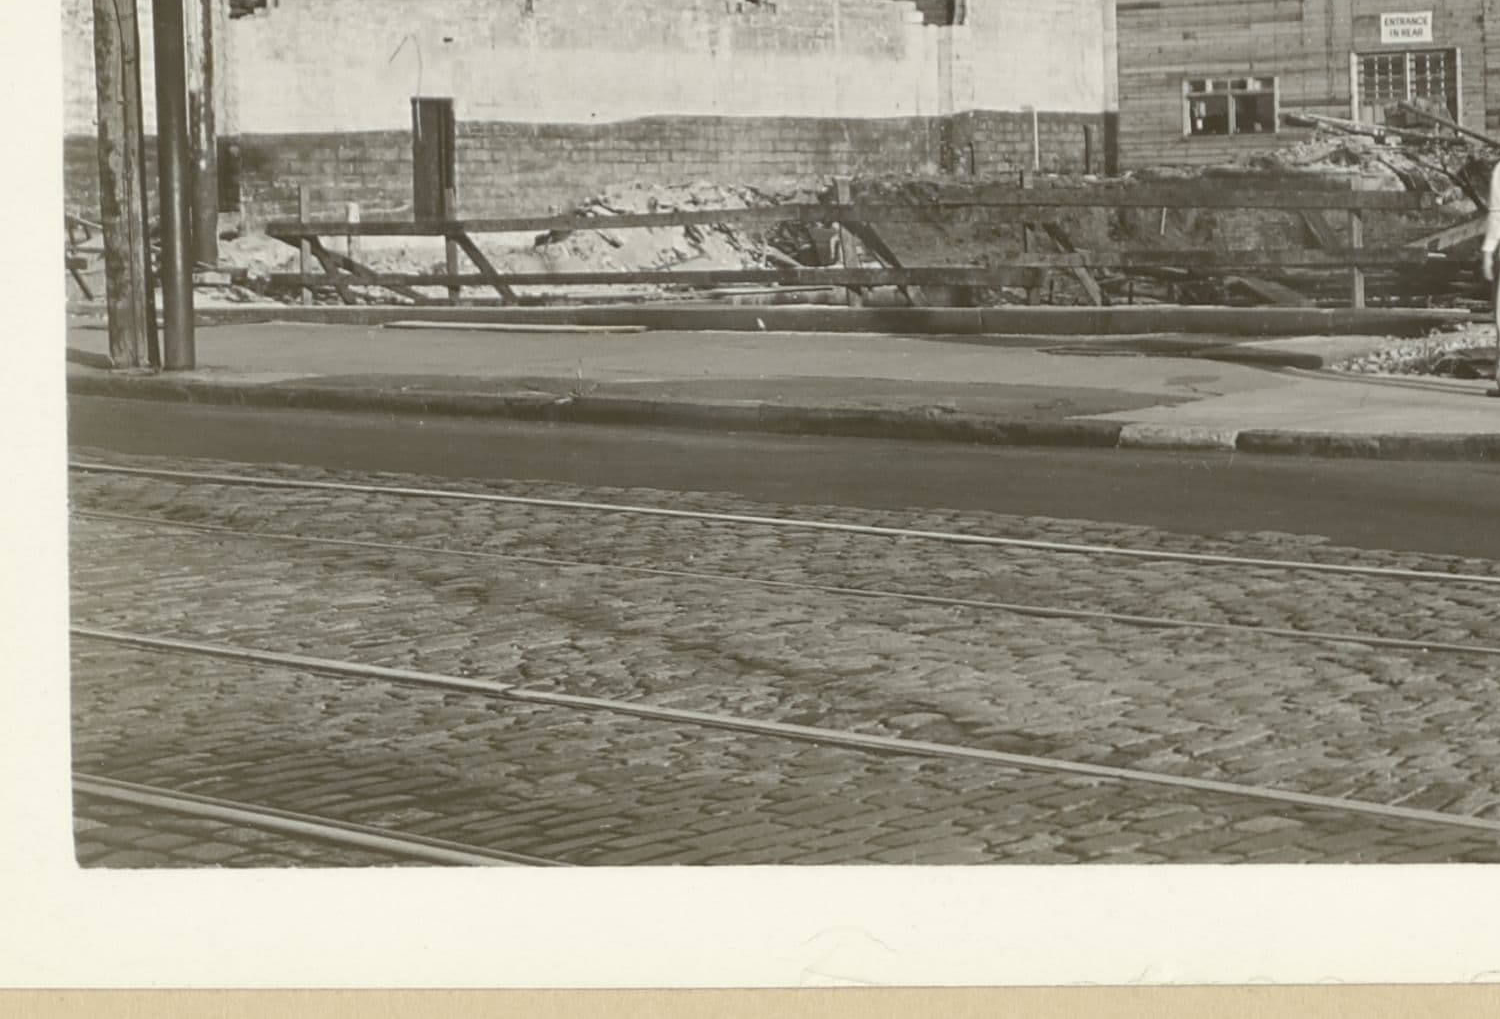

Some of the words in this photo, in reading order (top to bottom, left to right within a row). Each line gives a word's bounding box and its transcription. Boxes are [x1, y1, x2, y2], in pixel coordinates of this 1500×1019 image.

[1384, 16, 1428, 27] ENTRANCE
[1389, 29, 1399, 38] IN
[1401, 28, 1423, 38] REAR
